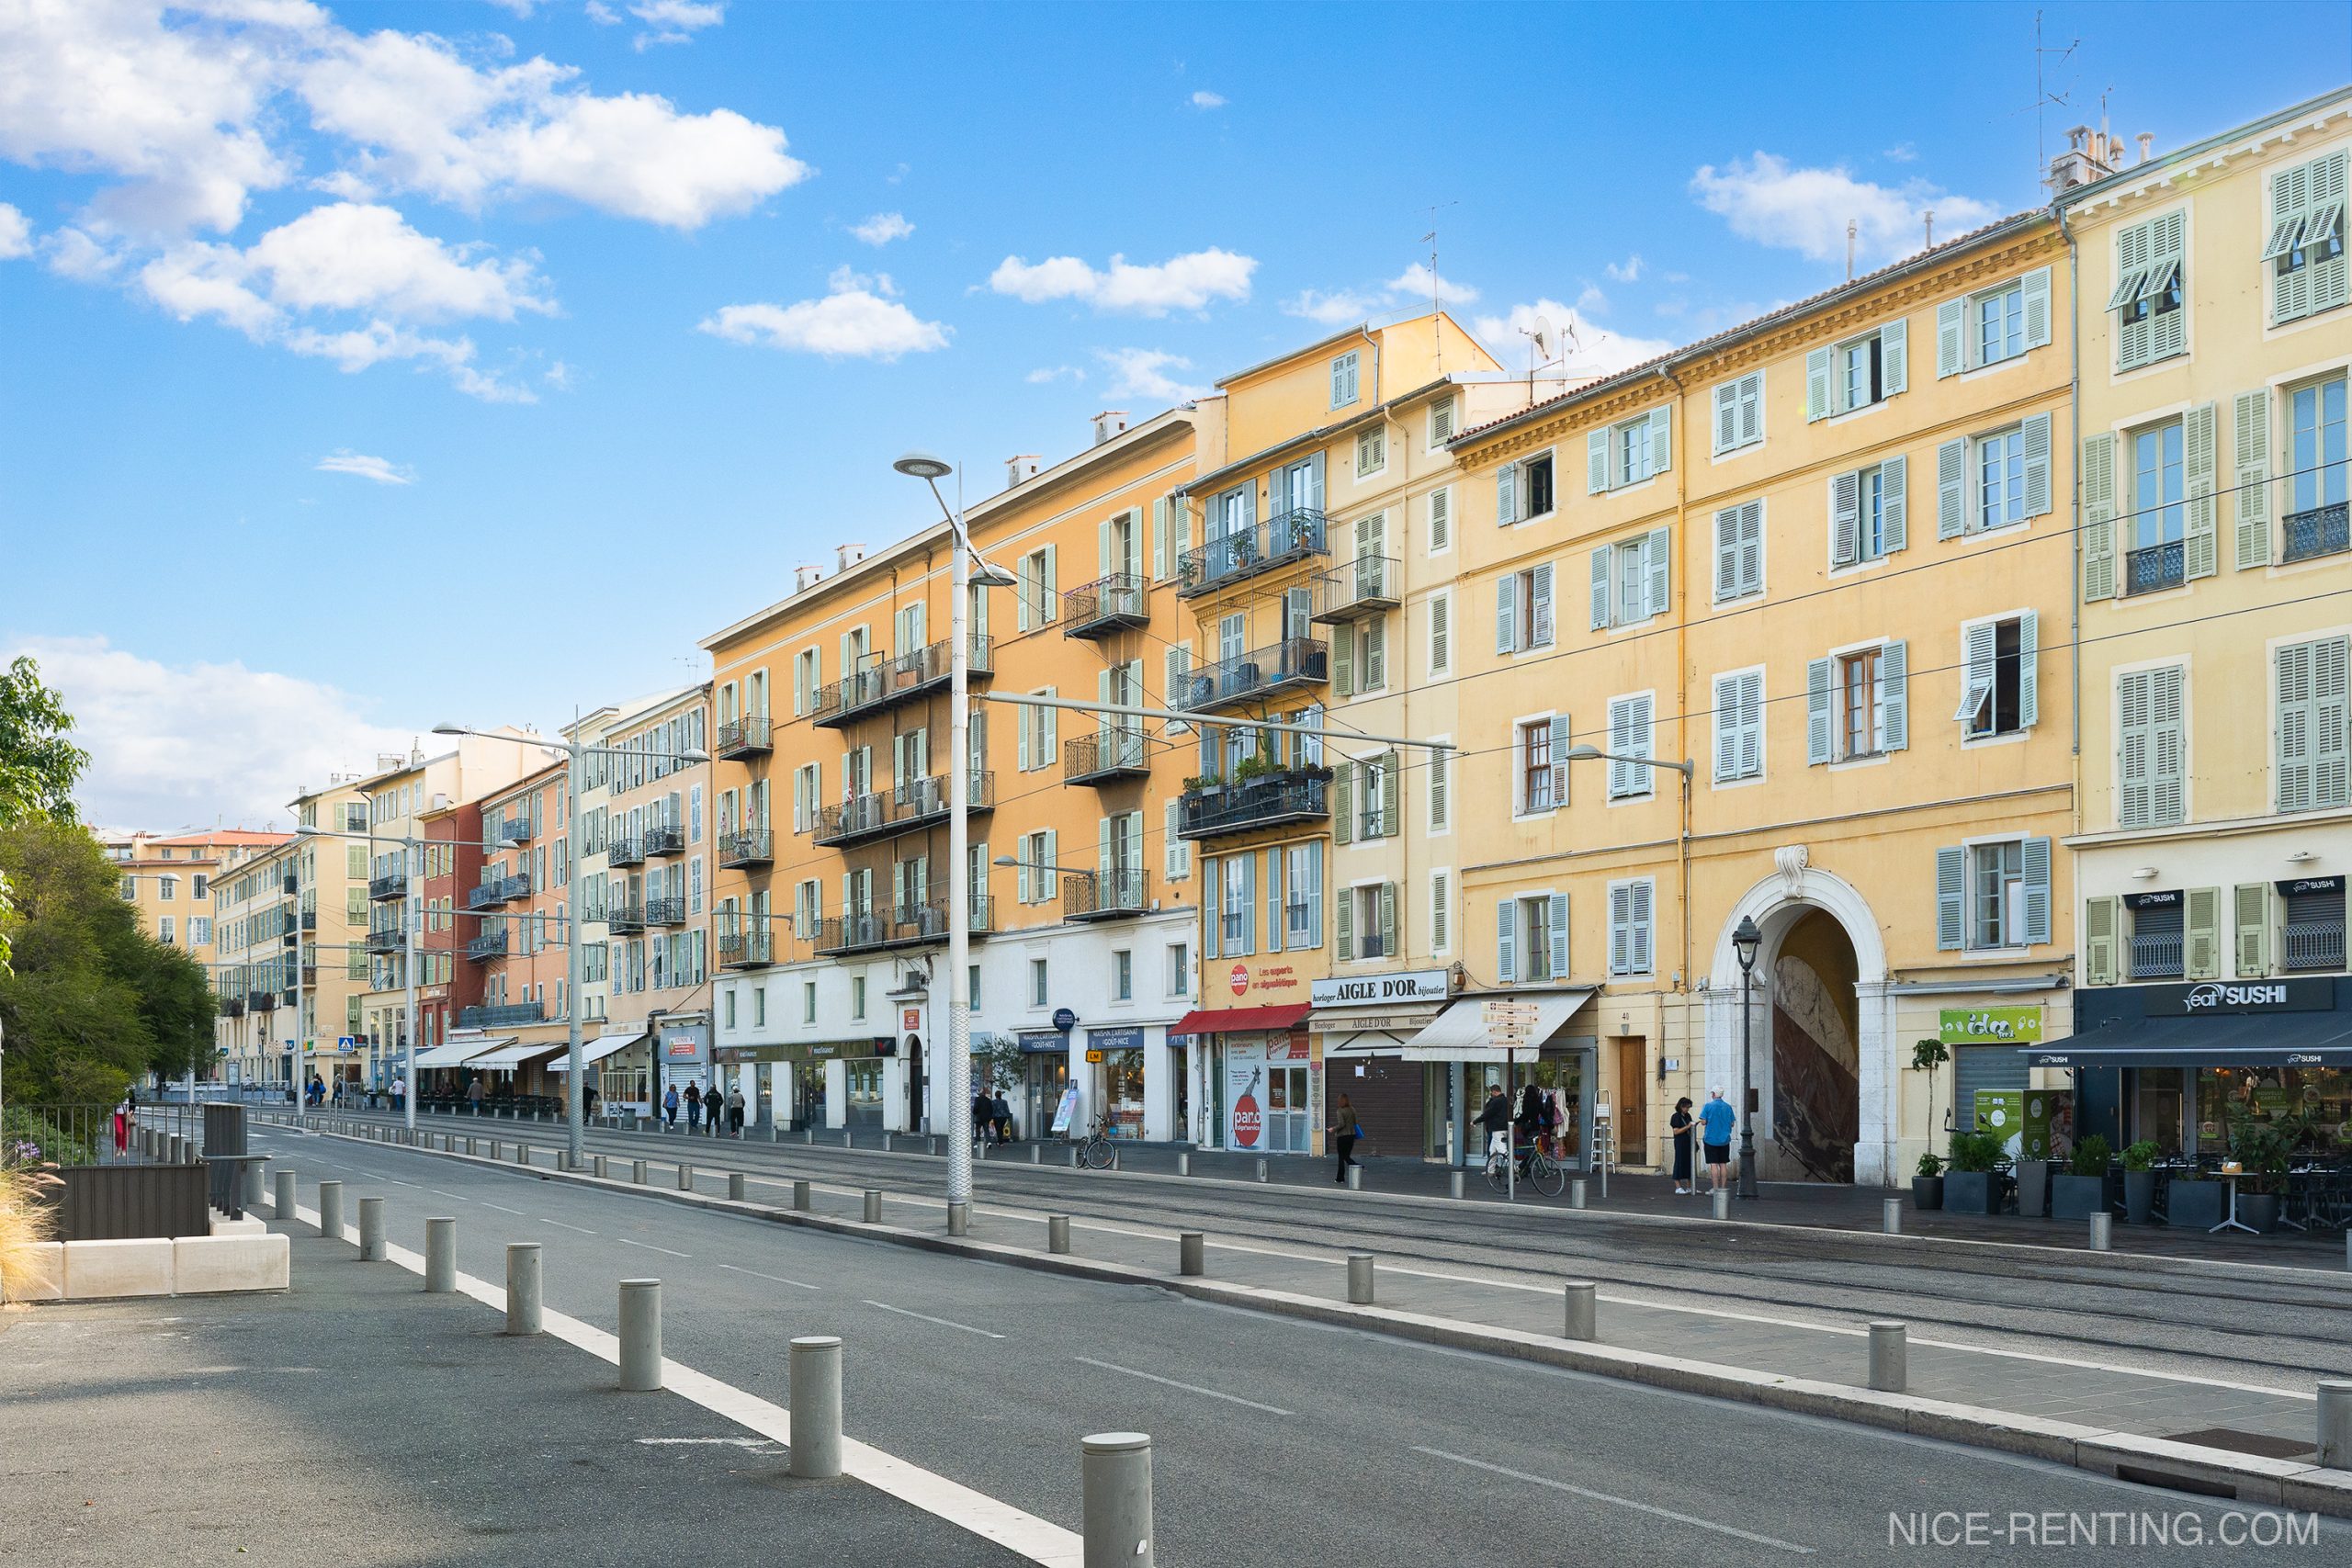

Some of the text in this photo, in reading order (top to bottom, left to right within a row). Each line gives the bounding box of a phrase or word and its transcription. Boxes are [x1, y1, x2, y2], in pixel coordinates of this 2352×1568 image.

[2310, 880, 2335, 889] SUSHI
[2153, 894, 2175, 903] SUSHI
[1259, 968, 1269, 976] Les
[1231, 973, 1248, 984] pano
[1313, 979, 1445, 1003] horloger AIGLE D'OR bijoutier
[2226, 985, 2287, 1005] SUSHI
[1622, 1012, 1630, 1021] 40
[1314, 1018, 1432, 1030] Horloger AIGLE D'OR Bijoutier
